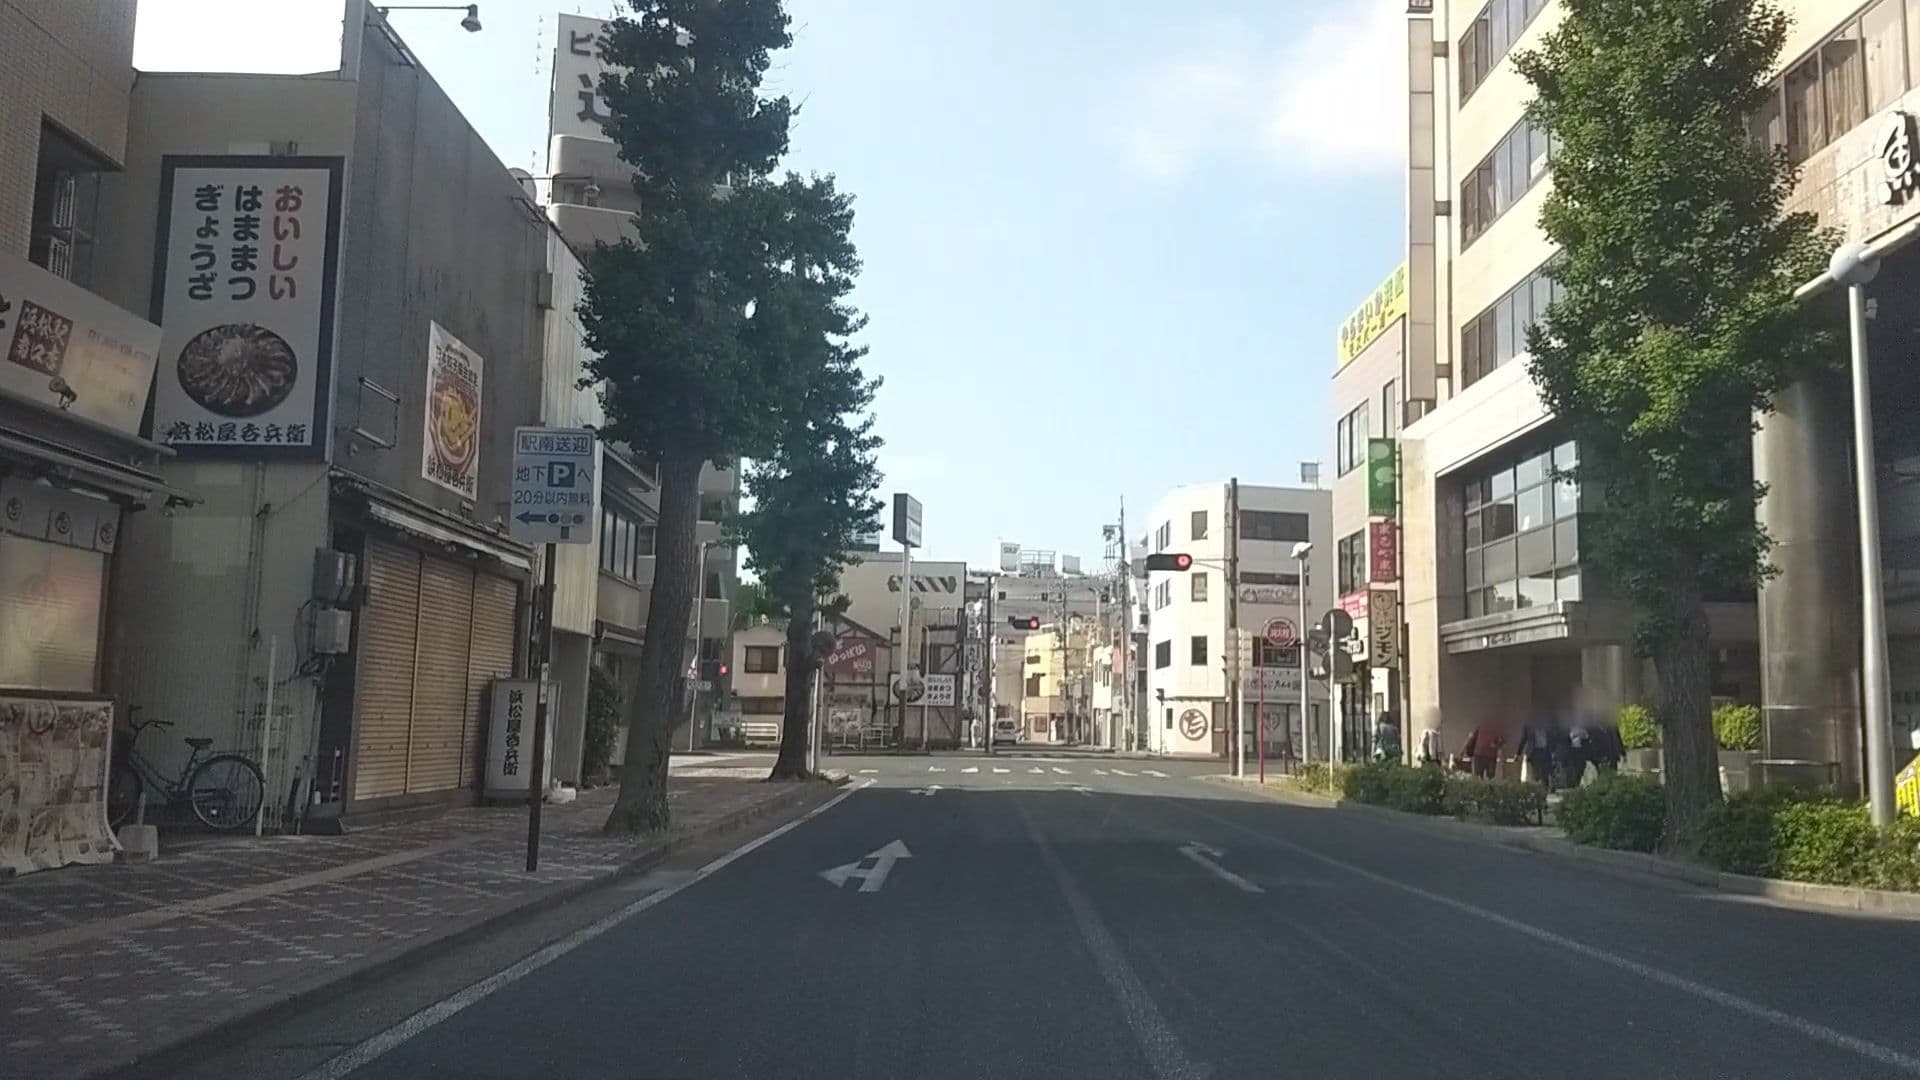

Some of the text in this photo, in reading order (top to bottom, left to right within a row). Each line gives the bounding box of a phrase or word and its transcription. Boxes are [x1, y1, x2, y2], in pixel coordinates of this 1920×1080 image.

[188, 184, 224, 300] ぎょうざ
[228, 184, 263, 300] はままつ
[269, 184, 303, 300] おいしい
[514, 489, 591, 505] 20分以内無料
[520, 434, 588, 453] 駅南送迎
